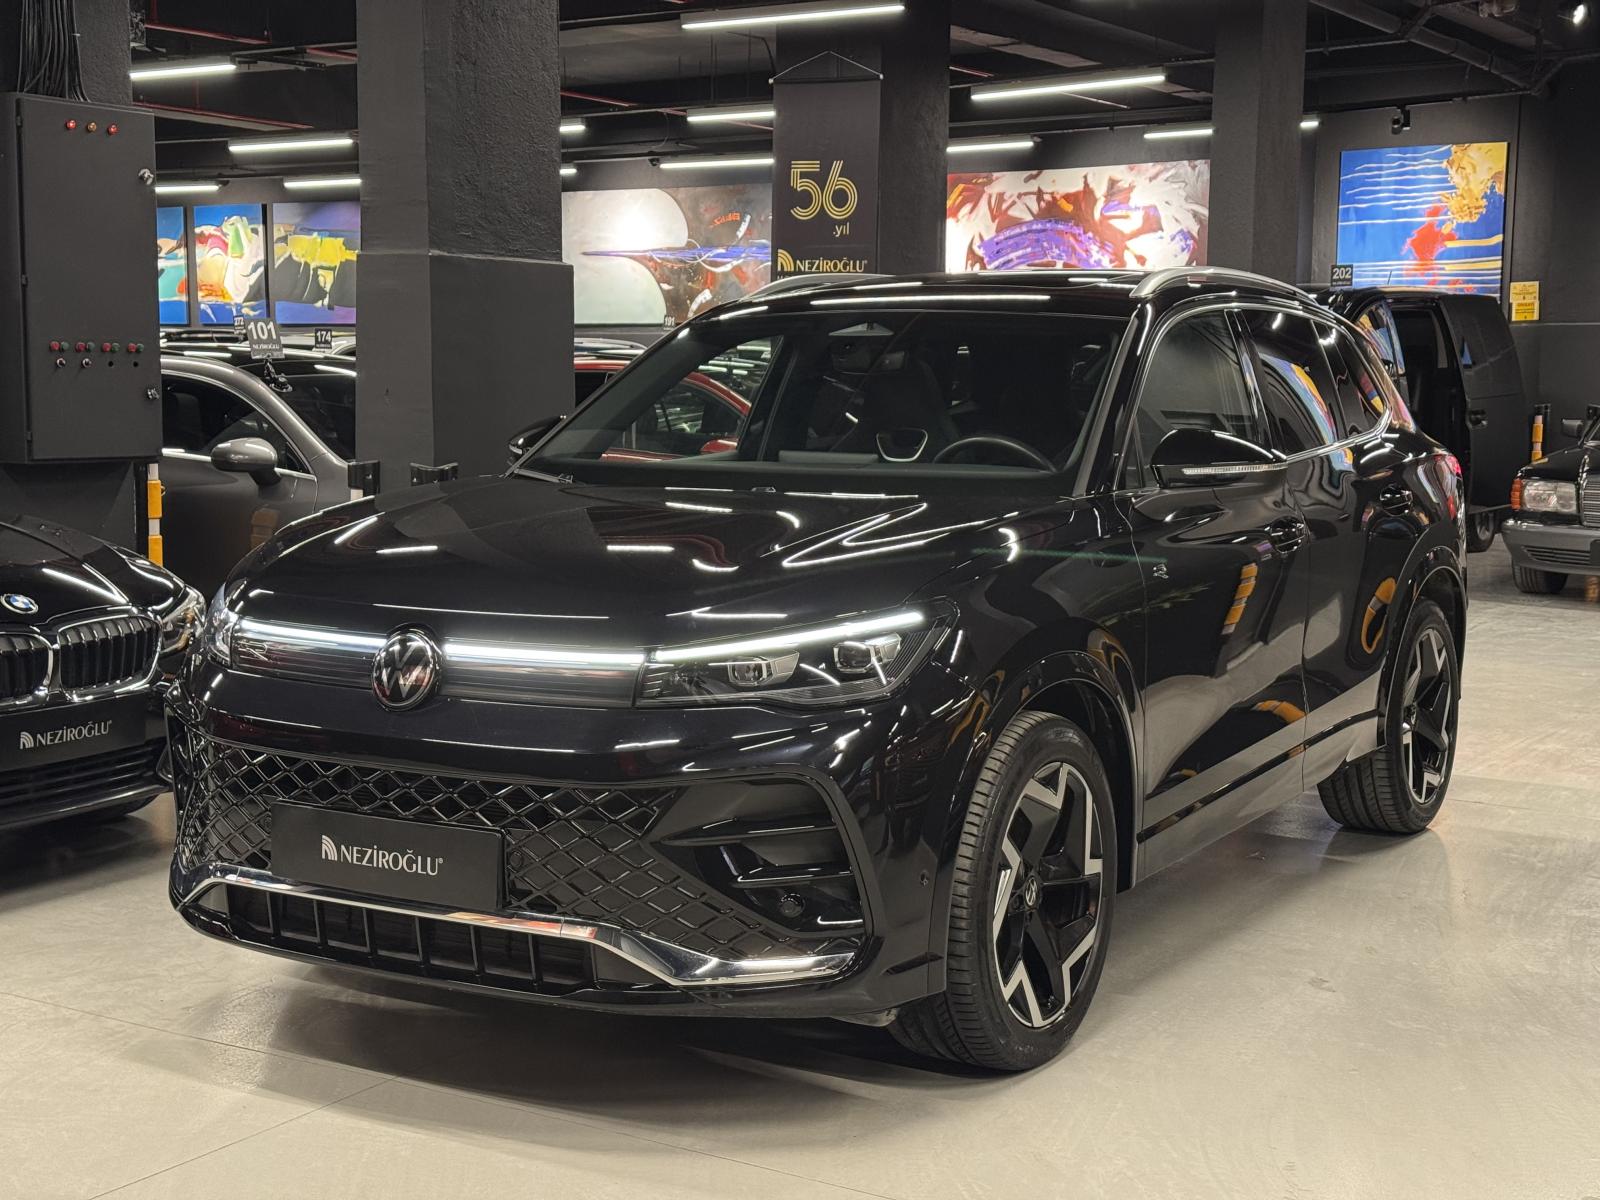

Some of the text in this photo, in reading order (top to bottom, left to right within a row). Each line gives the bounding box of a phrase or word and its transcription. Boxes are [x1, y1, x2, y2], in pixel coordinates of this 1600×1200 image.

[790, 160, 858, 220] 56
[796, 256, 865, 273] NEZİROĞLU
[1332, 267, 1352, 280] 202
[247, 320, 277, 340] 101
[316, 330, 331, 342] 174
[36, 720, 110, 748] NEZİROĞLU
[340, 844, 440, 876] NEZİROĞLU
